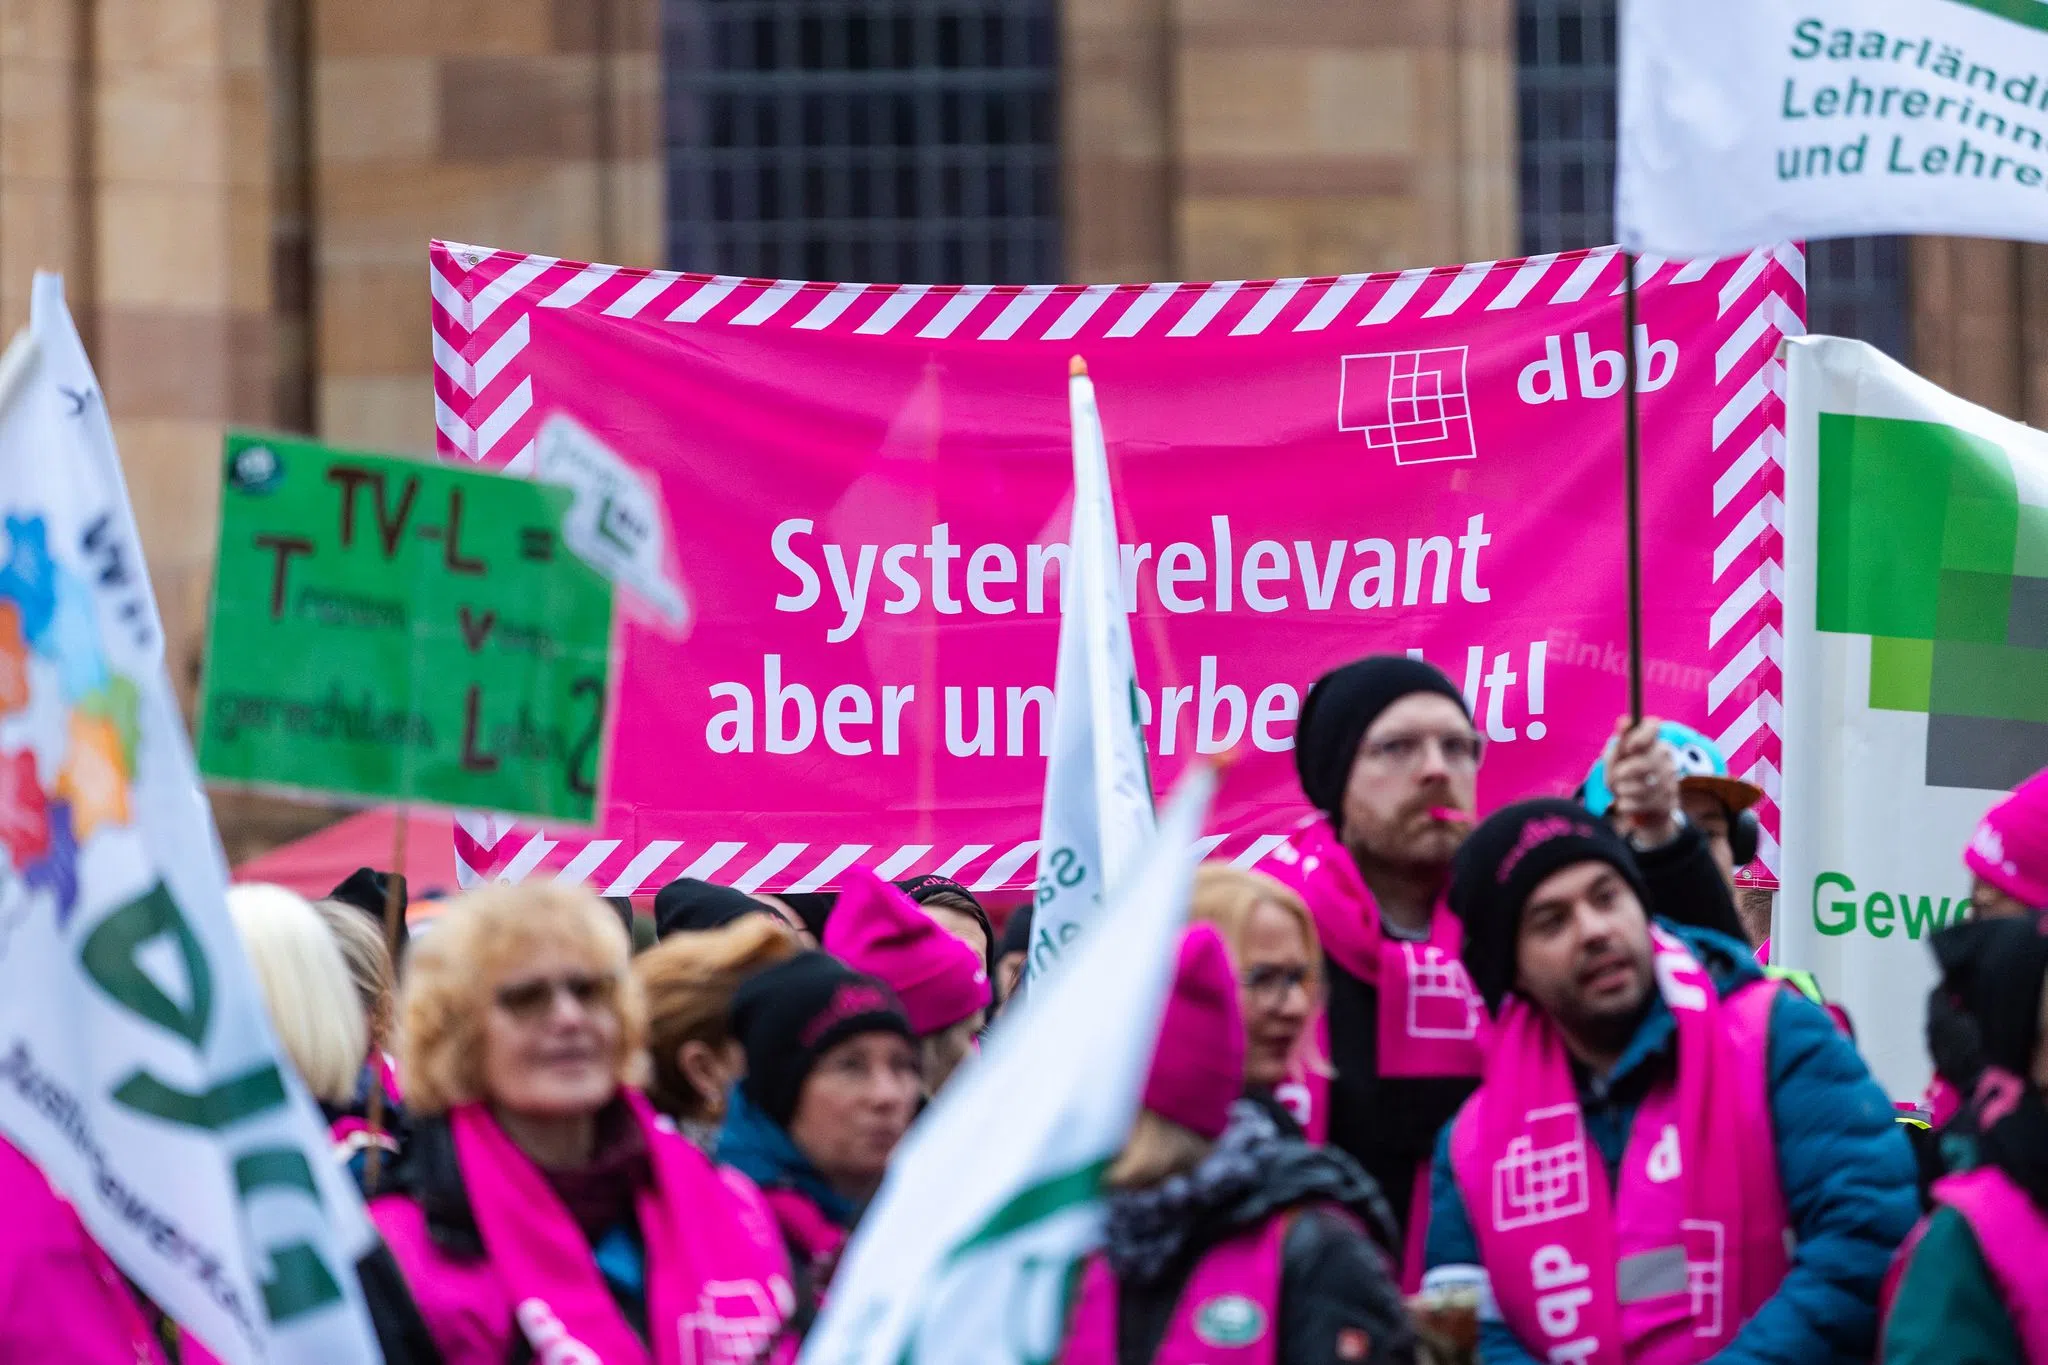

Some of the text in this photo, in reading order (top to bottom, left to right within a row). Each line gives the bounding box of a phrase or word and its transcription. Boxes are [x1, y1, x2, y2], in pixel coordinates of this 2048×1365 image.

[1782, 76, 2048, 151] Lehrerinn
[1777, 134, 2048, 188] und Lehre
[1517, 323, 1679, 405] dbb
[327, 466, 487, 574] TV-L
[705, 641, 1548, 758] aber unrbelt!
